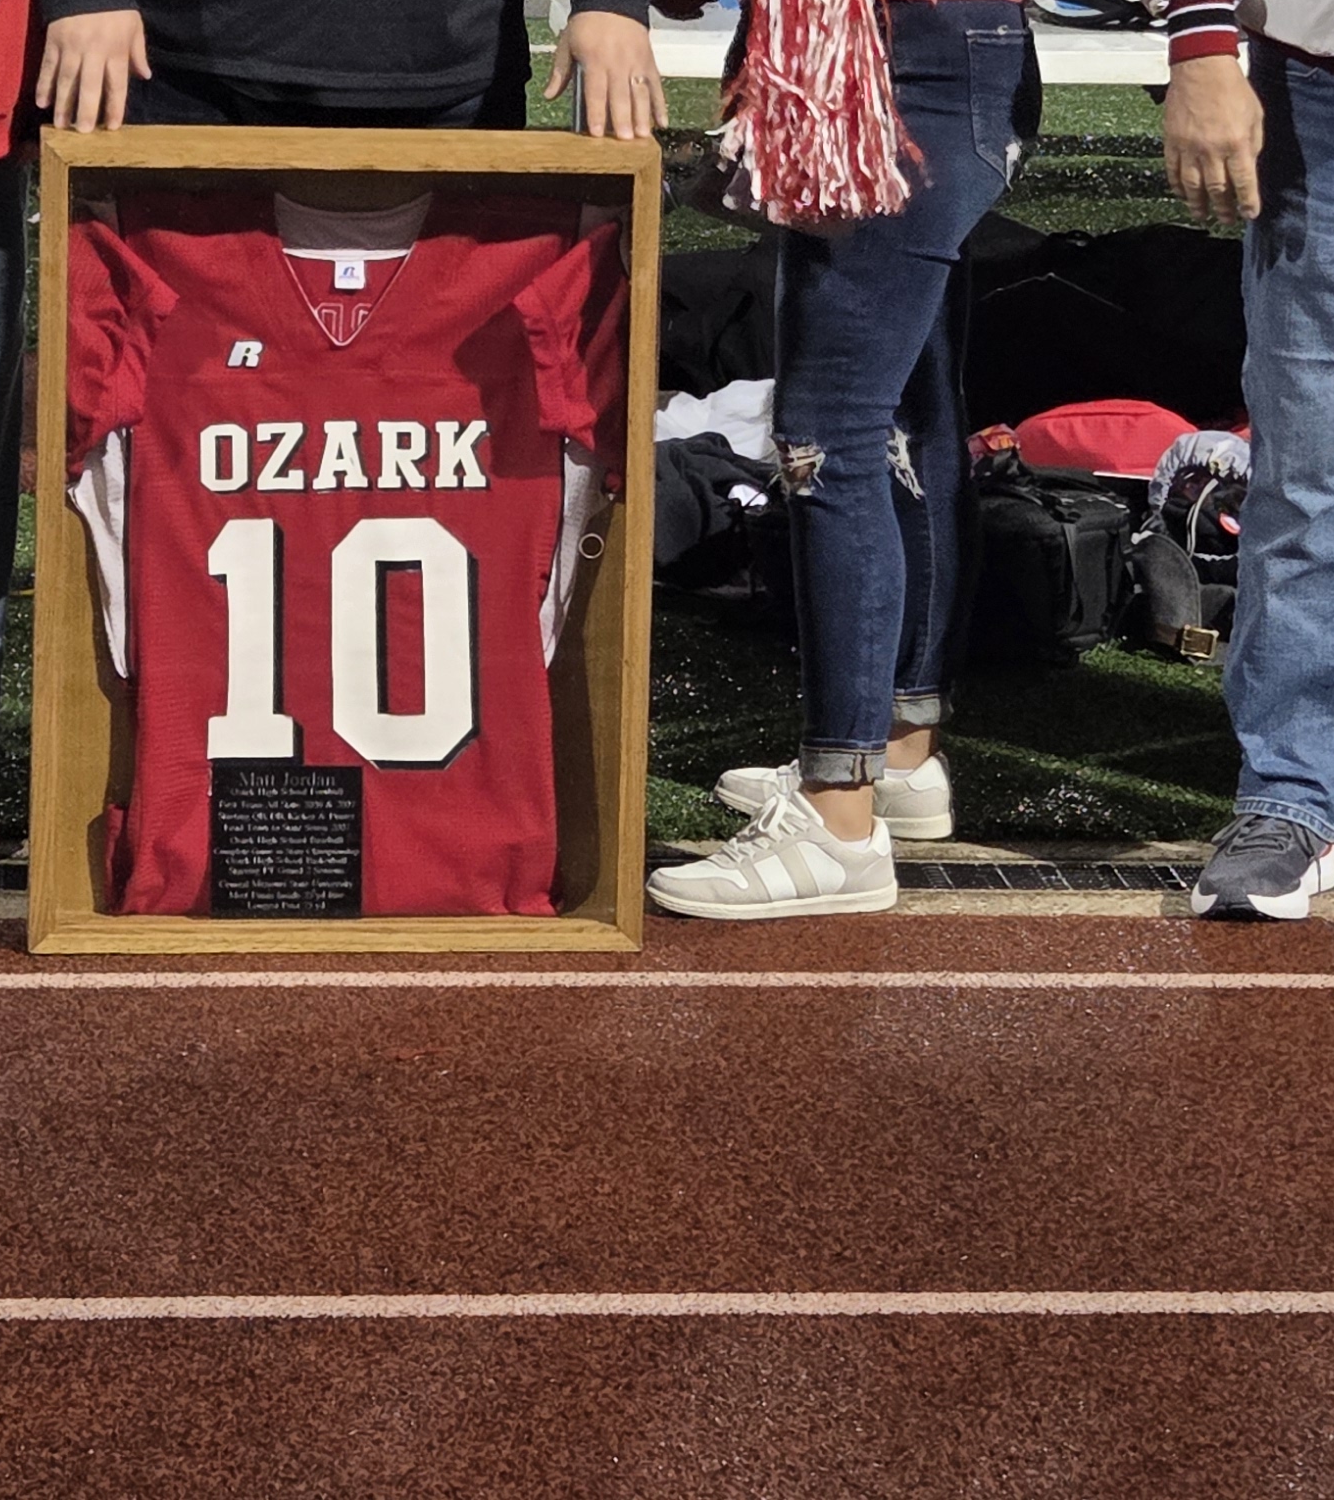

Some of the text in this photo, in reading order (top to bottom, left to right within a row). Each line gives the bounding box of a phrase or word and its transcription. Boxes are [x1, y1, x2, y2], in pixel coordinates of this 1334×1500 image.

[200, 419, 490, 493] OZARK
[206, 516, 480, 771] 10
[239, 771, 336, 787] Matt Jordan
